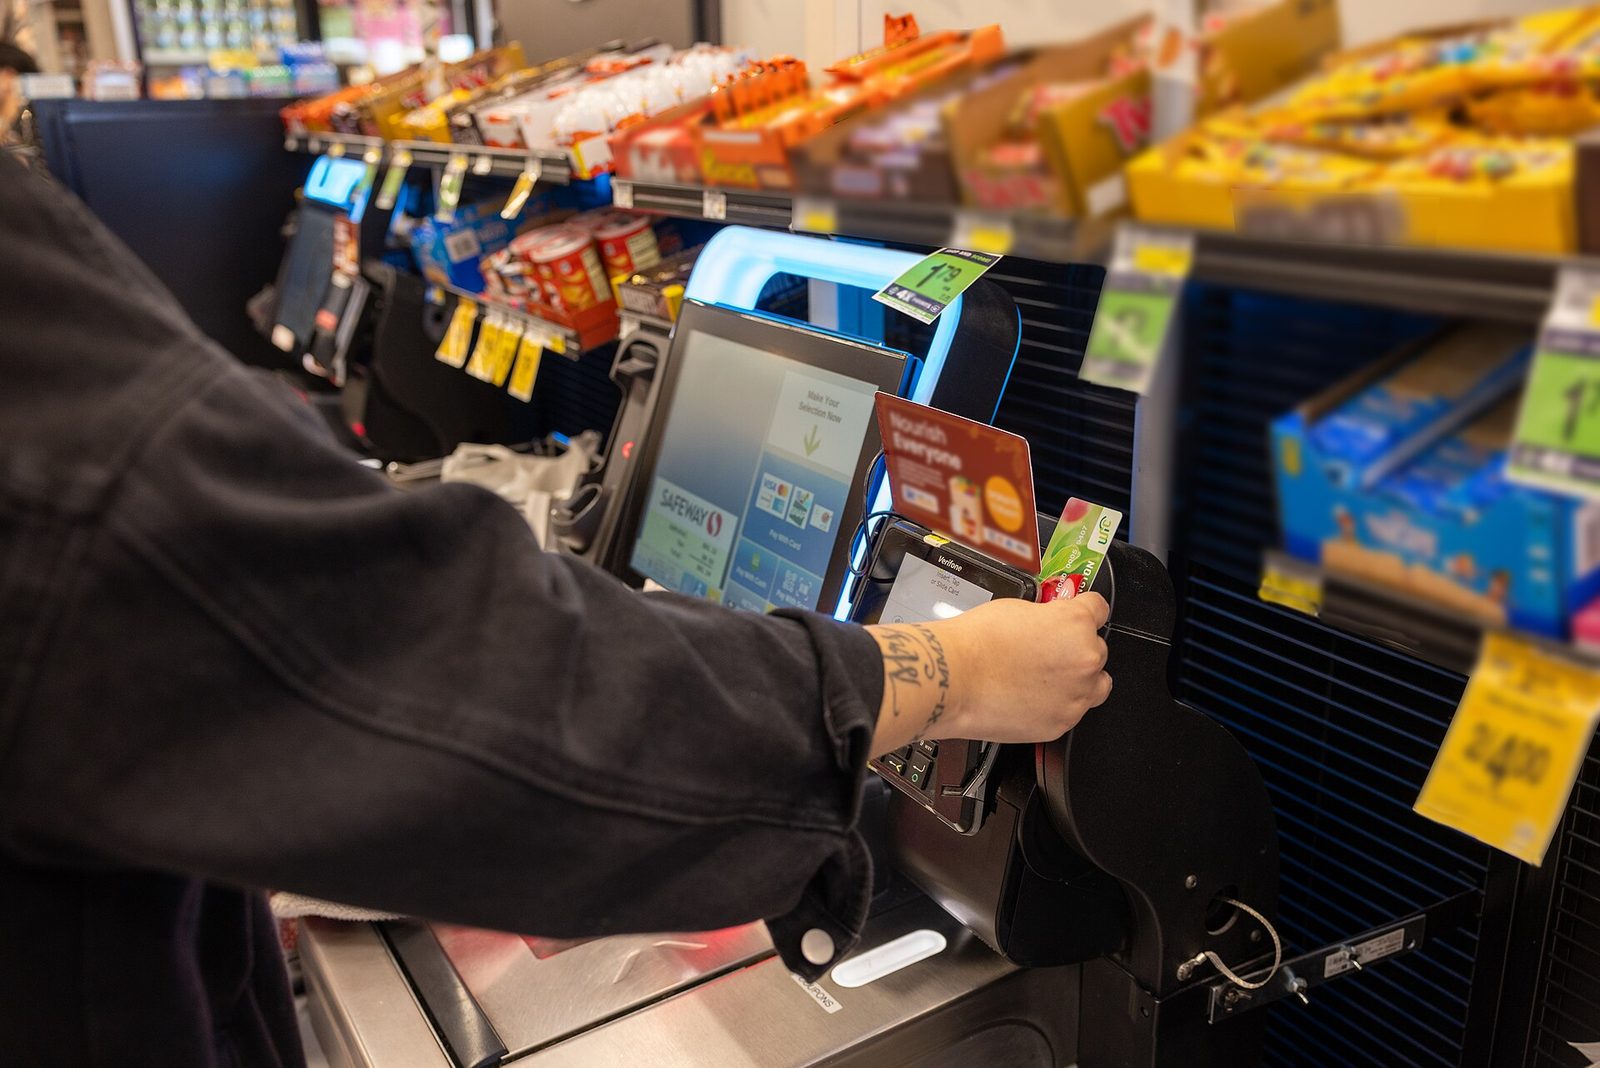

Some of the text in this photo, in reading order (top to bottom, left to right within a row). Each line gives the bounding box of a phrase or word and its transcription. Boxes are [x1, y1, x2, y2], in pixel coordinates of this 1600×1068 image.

[798, 401, 842, 423] Selection Now
[807, 390, 841, 408] Make Your
[888, 411, 948, 446] Nourish
[892, 431, 963, 471] Everyone
[660, 488, 709, 527] SAFEWAY
[938, 555, 962, 572] Verifone
